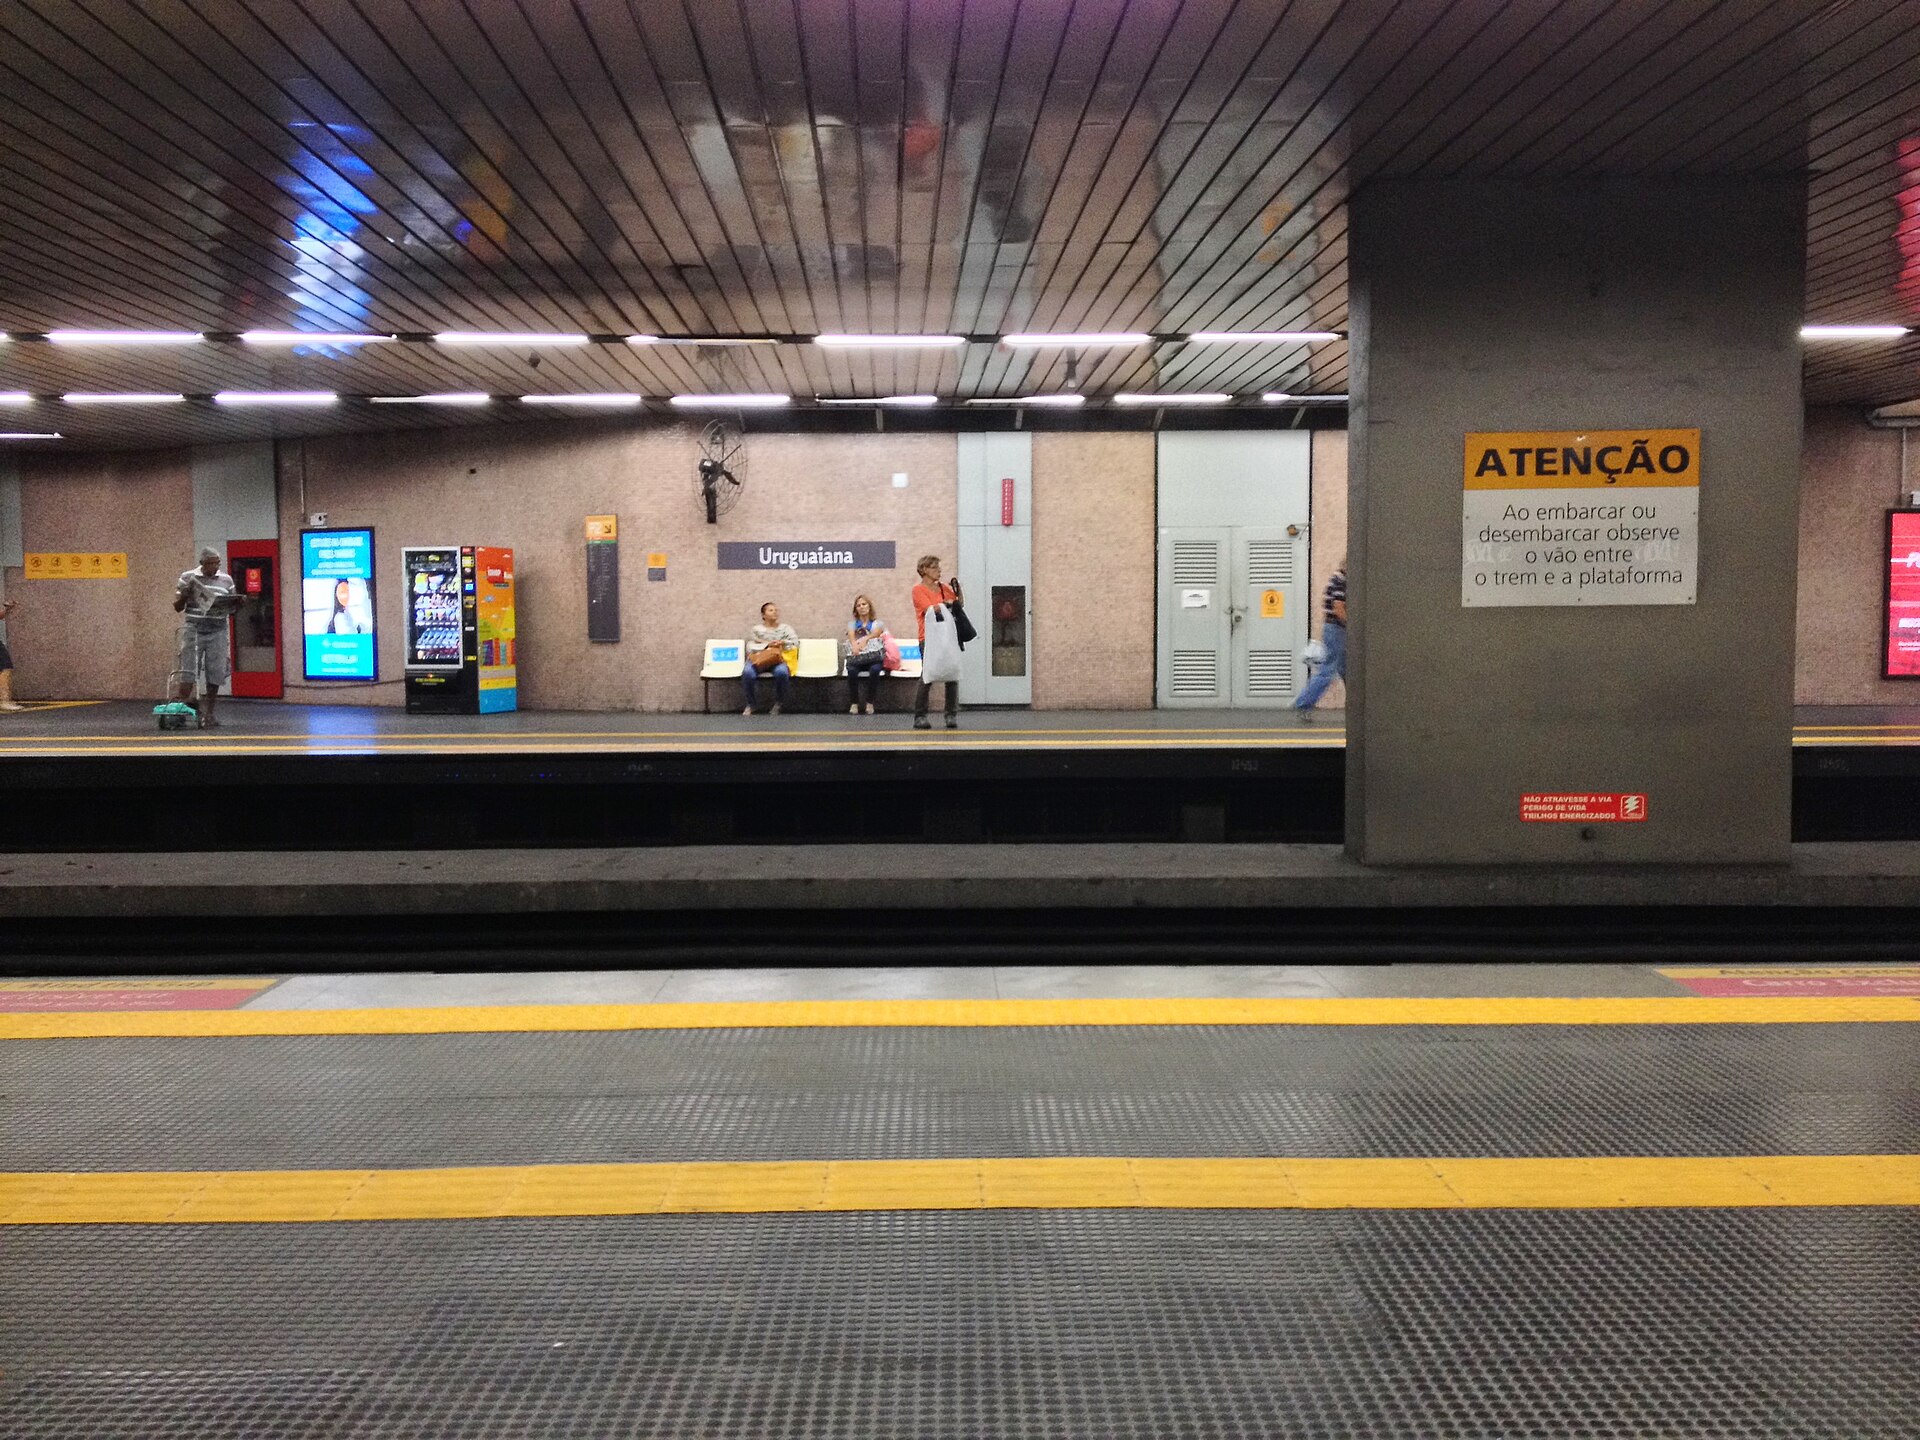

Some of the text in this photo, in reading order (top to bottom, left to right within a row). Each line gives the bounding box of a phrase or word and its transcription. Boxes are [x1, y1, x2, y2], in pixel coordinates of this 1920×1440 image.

[1474, 439, 1690, 484] ATENÇÃO
[1502, 503, 1656, 521] Ao embarcar ou
[1479, 524, 1680, 543] desembarcar observe
[759, 546, 854, 570] Uruguaiana
[1525, 550, 1537, 564] o
[1544, 547, 1577, 564] vão
[1583, 546, 1633, 563] entre
[1475, 566, 1682, 588] o trem e a plataforma
